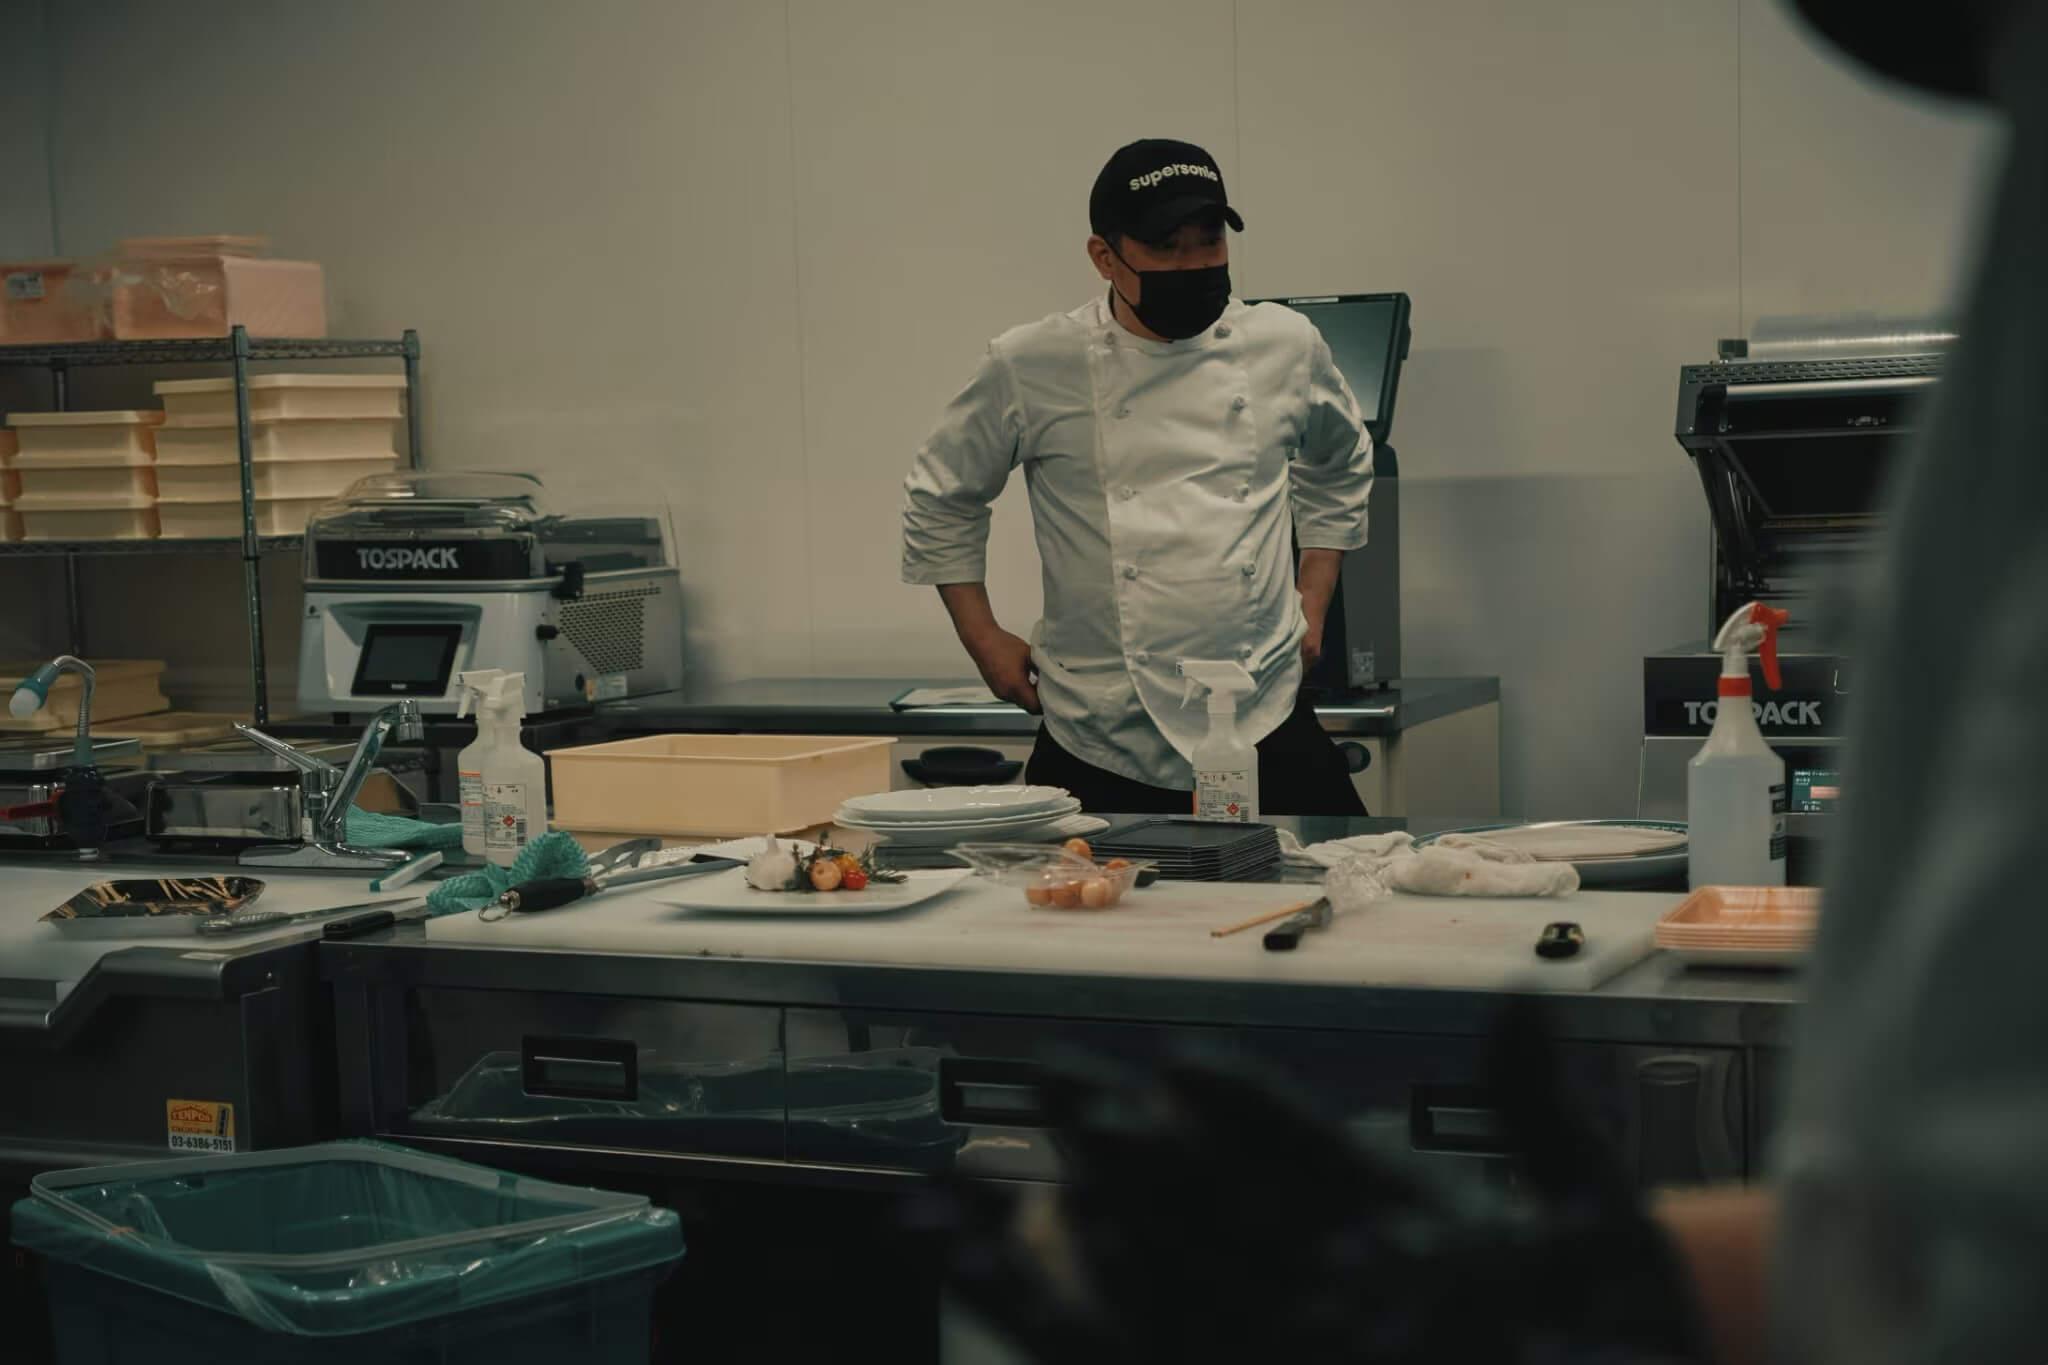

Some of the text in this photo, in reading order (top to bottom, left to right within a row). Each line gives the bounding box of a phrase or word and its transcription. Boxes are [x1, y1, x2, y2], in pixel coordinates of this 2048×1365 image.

[1129, 163, 1218, 191] supersonic
[356, 547, 459, 569] TOSPACK
[1683, 700, 1822, 726] TOACK
